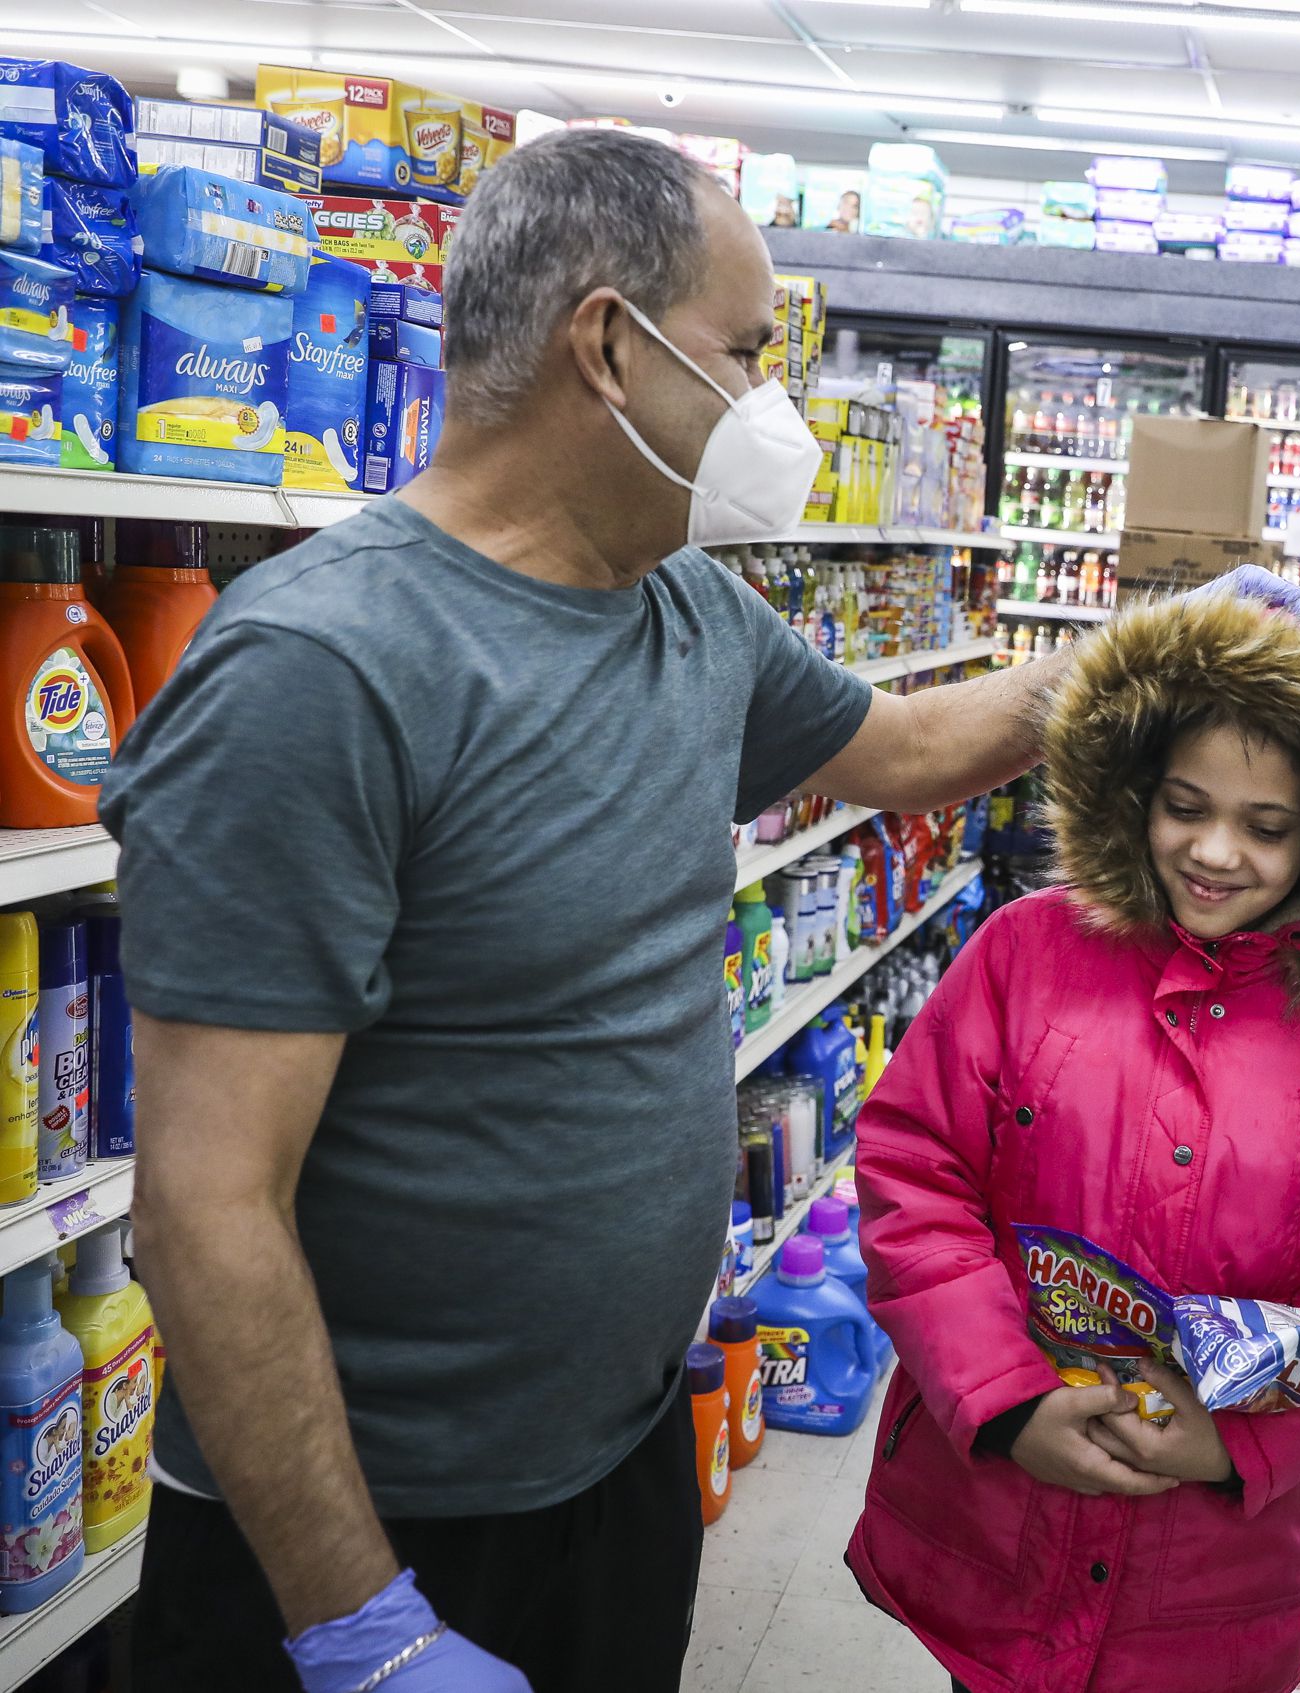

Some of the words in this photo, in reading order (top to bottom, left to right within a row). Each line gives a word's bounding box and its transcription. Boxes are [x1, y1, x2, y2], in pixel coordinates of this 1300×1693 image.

[348, 84, 364, 102] 12
[364, 87, 384, 98] PACK
[416, 123, 451, 146] Velveeta
[485, 114, 497, 132] 12
[76, 199, 116, 219] Stayfree
[334, 239, 349, 247] BAGS
[12, 272, 51, 306] always
[290, 332, 365, 374] Stayfree
[175, 344, 271, 395] always
[336, 370, 354, 381] maxi
[215, 383, 238, 394] MAXI
[157, 419, 166, 439] 1
[418, 396, 430, 468] TAMPAX
[153, 454, 163, 462] 24
[284, 440, 297, 453] 24
[40, 682, 82, 721] Tide
[57, 1090, 66, 1100] &
[63, 1207, 91, 1227] WIC
[1028, 1246, 1157, 1335] HARIBO
[1050, 1290, 1096, 1317] Sour
[1198, 1333, 1225, 1366] COIN
[102, 1363, 112, 1376] 45
[759, 1356, 806, 1385] TRA
[95, 1382, 152, 1456] Suavitel
[28, 1438, 80, 1497] Suavitel
[31, 1486, 61, 1519] Cuidado
